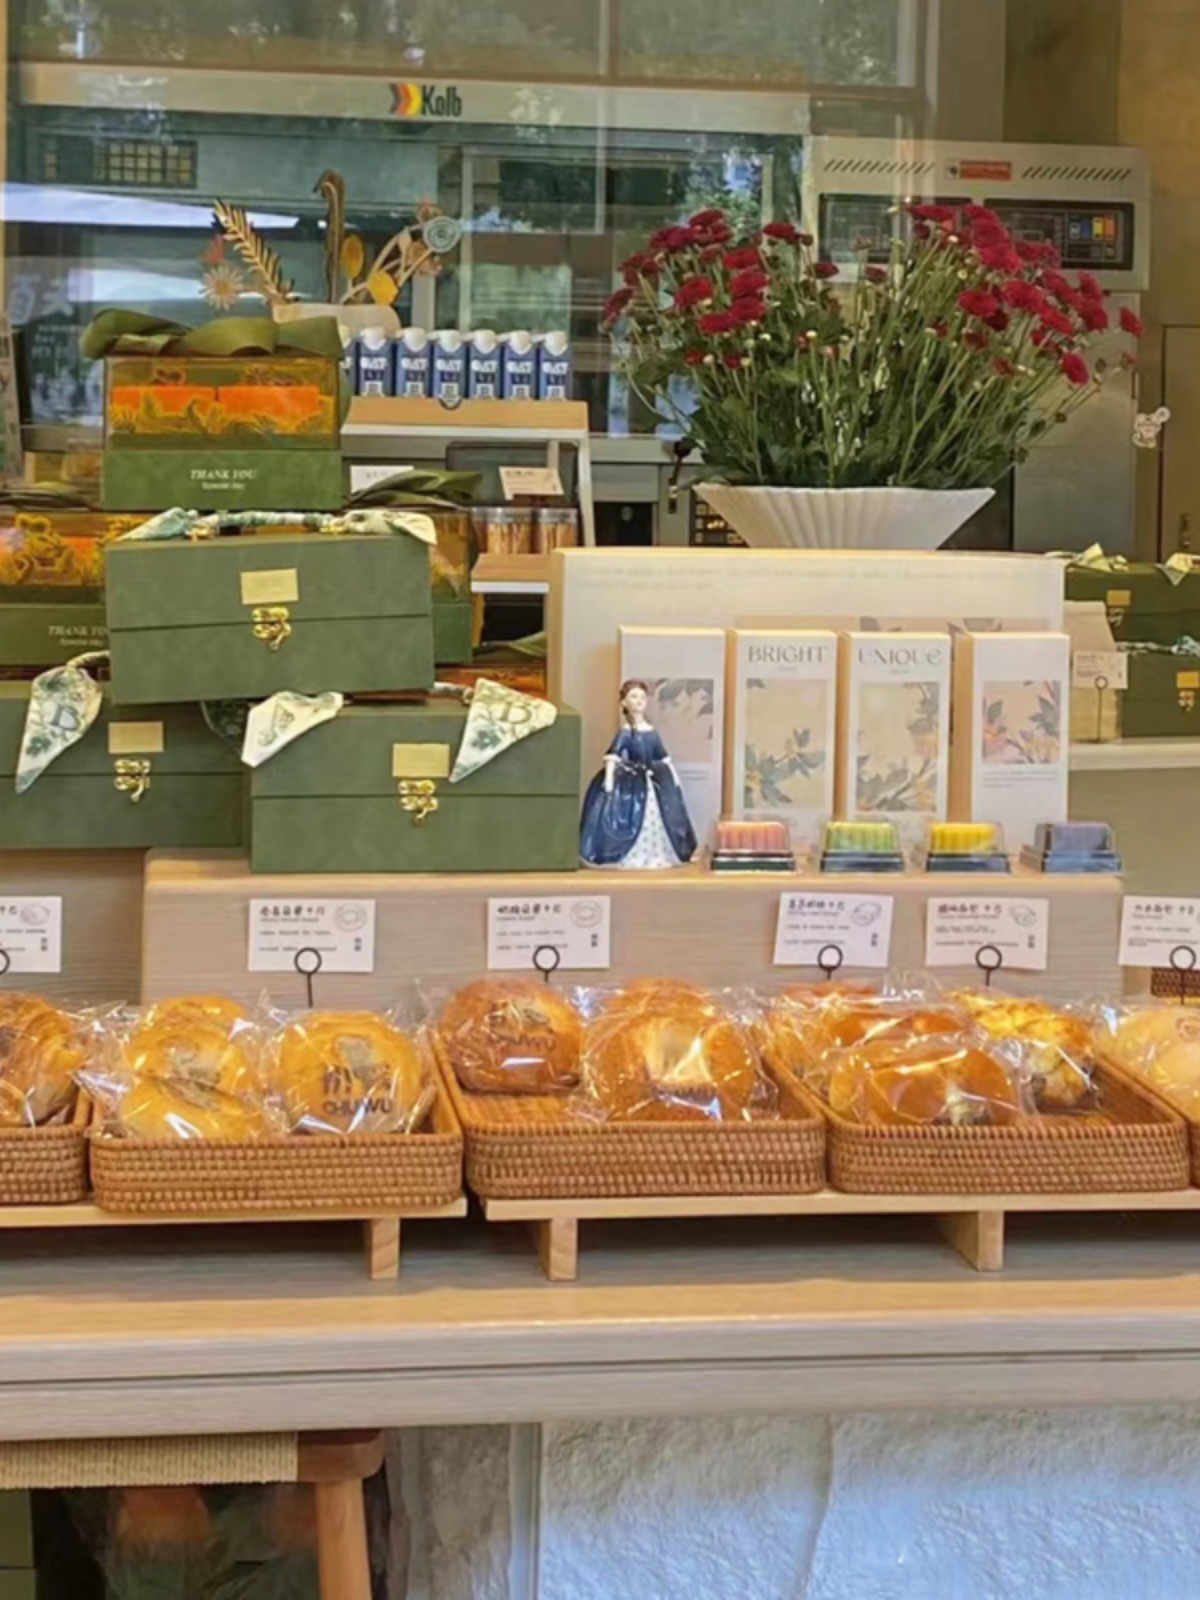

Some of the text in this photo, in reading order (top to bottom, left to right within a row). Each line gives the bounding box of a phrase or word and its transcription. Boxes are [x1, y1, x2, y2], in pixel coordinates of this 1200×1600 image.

[421, 84, 462, 117] Kolb
[190, 468, 258, 480] THANK YOU
[48, 624, 88, 637] THANK
[748, 644, 828, 663] BRIGHT
